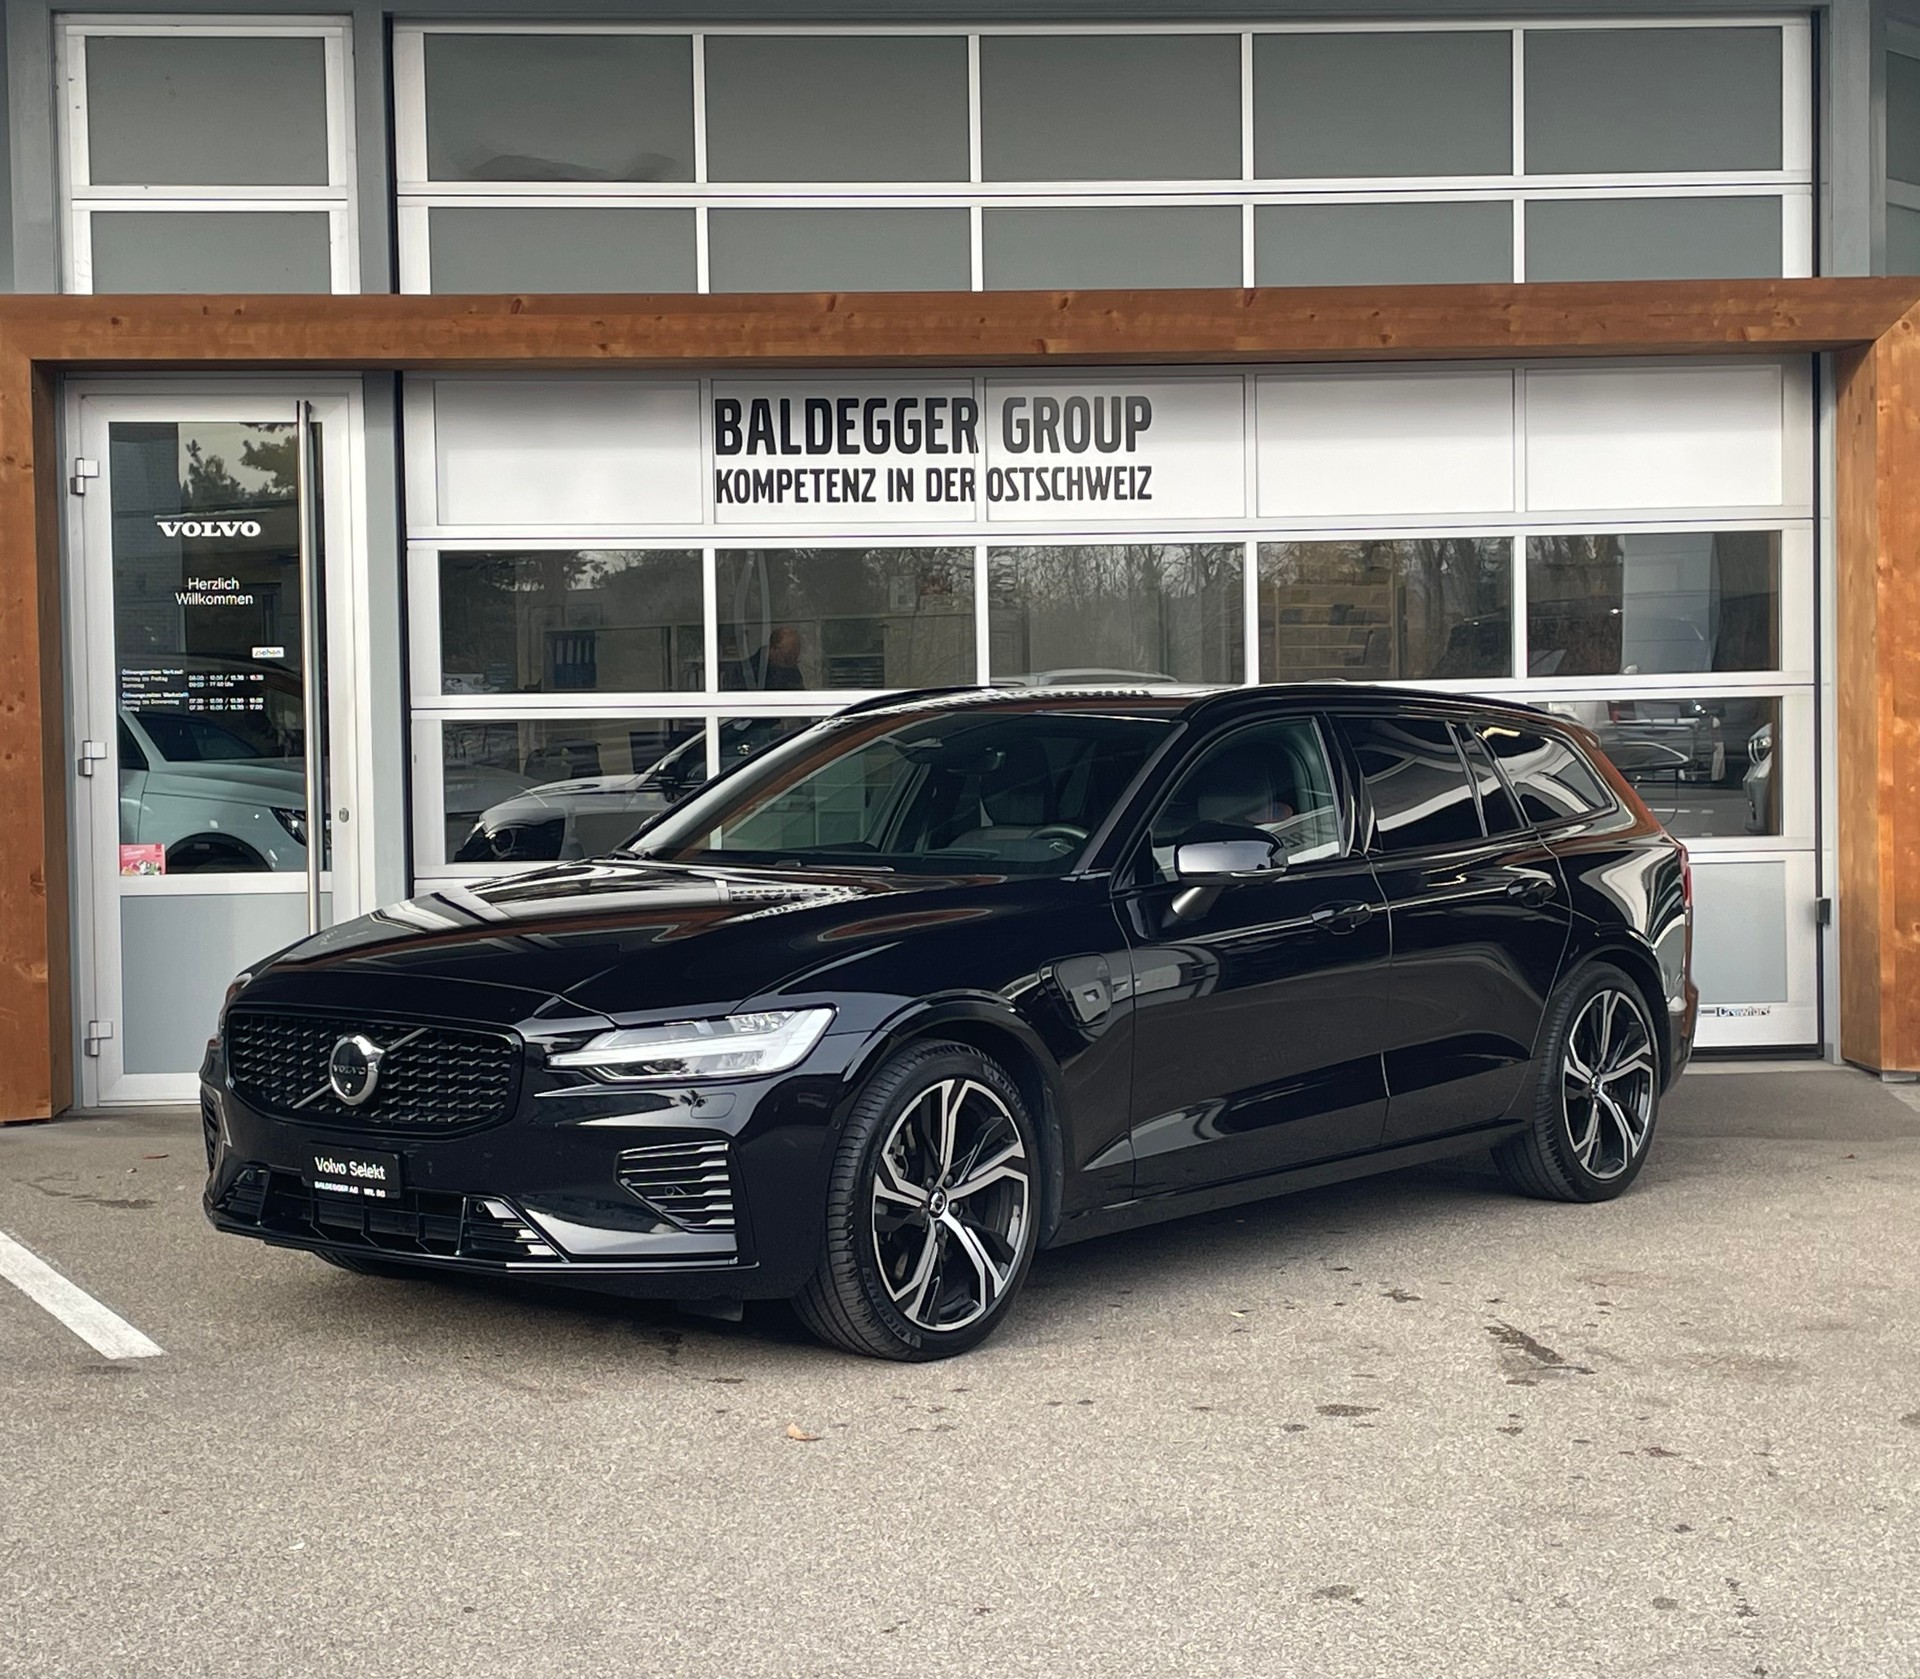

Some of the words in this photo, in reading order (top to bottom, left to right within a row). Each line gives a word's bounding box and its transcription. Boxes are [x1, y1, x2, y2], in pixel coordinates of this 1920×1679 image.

[715, 397, 979, 455] BALDEGGER
[1002, 396, 1152, 454] GROUP
[715, 468, 876, 504] KOMPETENZ
[887, 468, 914, 503] IN
[926, 467, 975, 502] DER
[986, 465, 1152, 502] OSTSCHWEIZ
[157, 521, 261, 537] VOLVO
[188, 577, 240, 590] Herzlich
[175, 592, 254, 605] Willkommen
[332, 1064, 367, 1076] VOLVO
[314, 1156, 347, 1175] Volvo
[349, 1161, 386, 1180] Selekt
